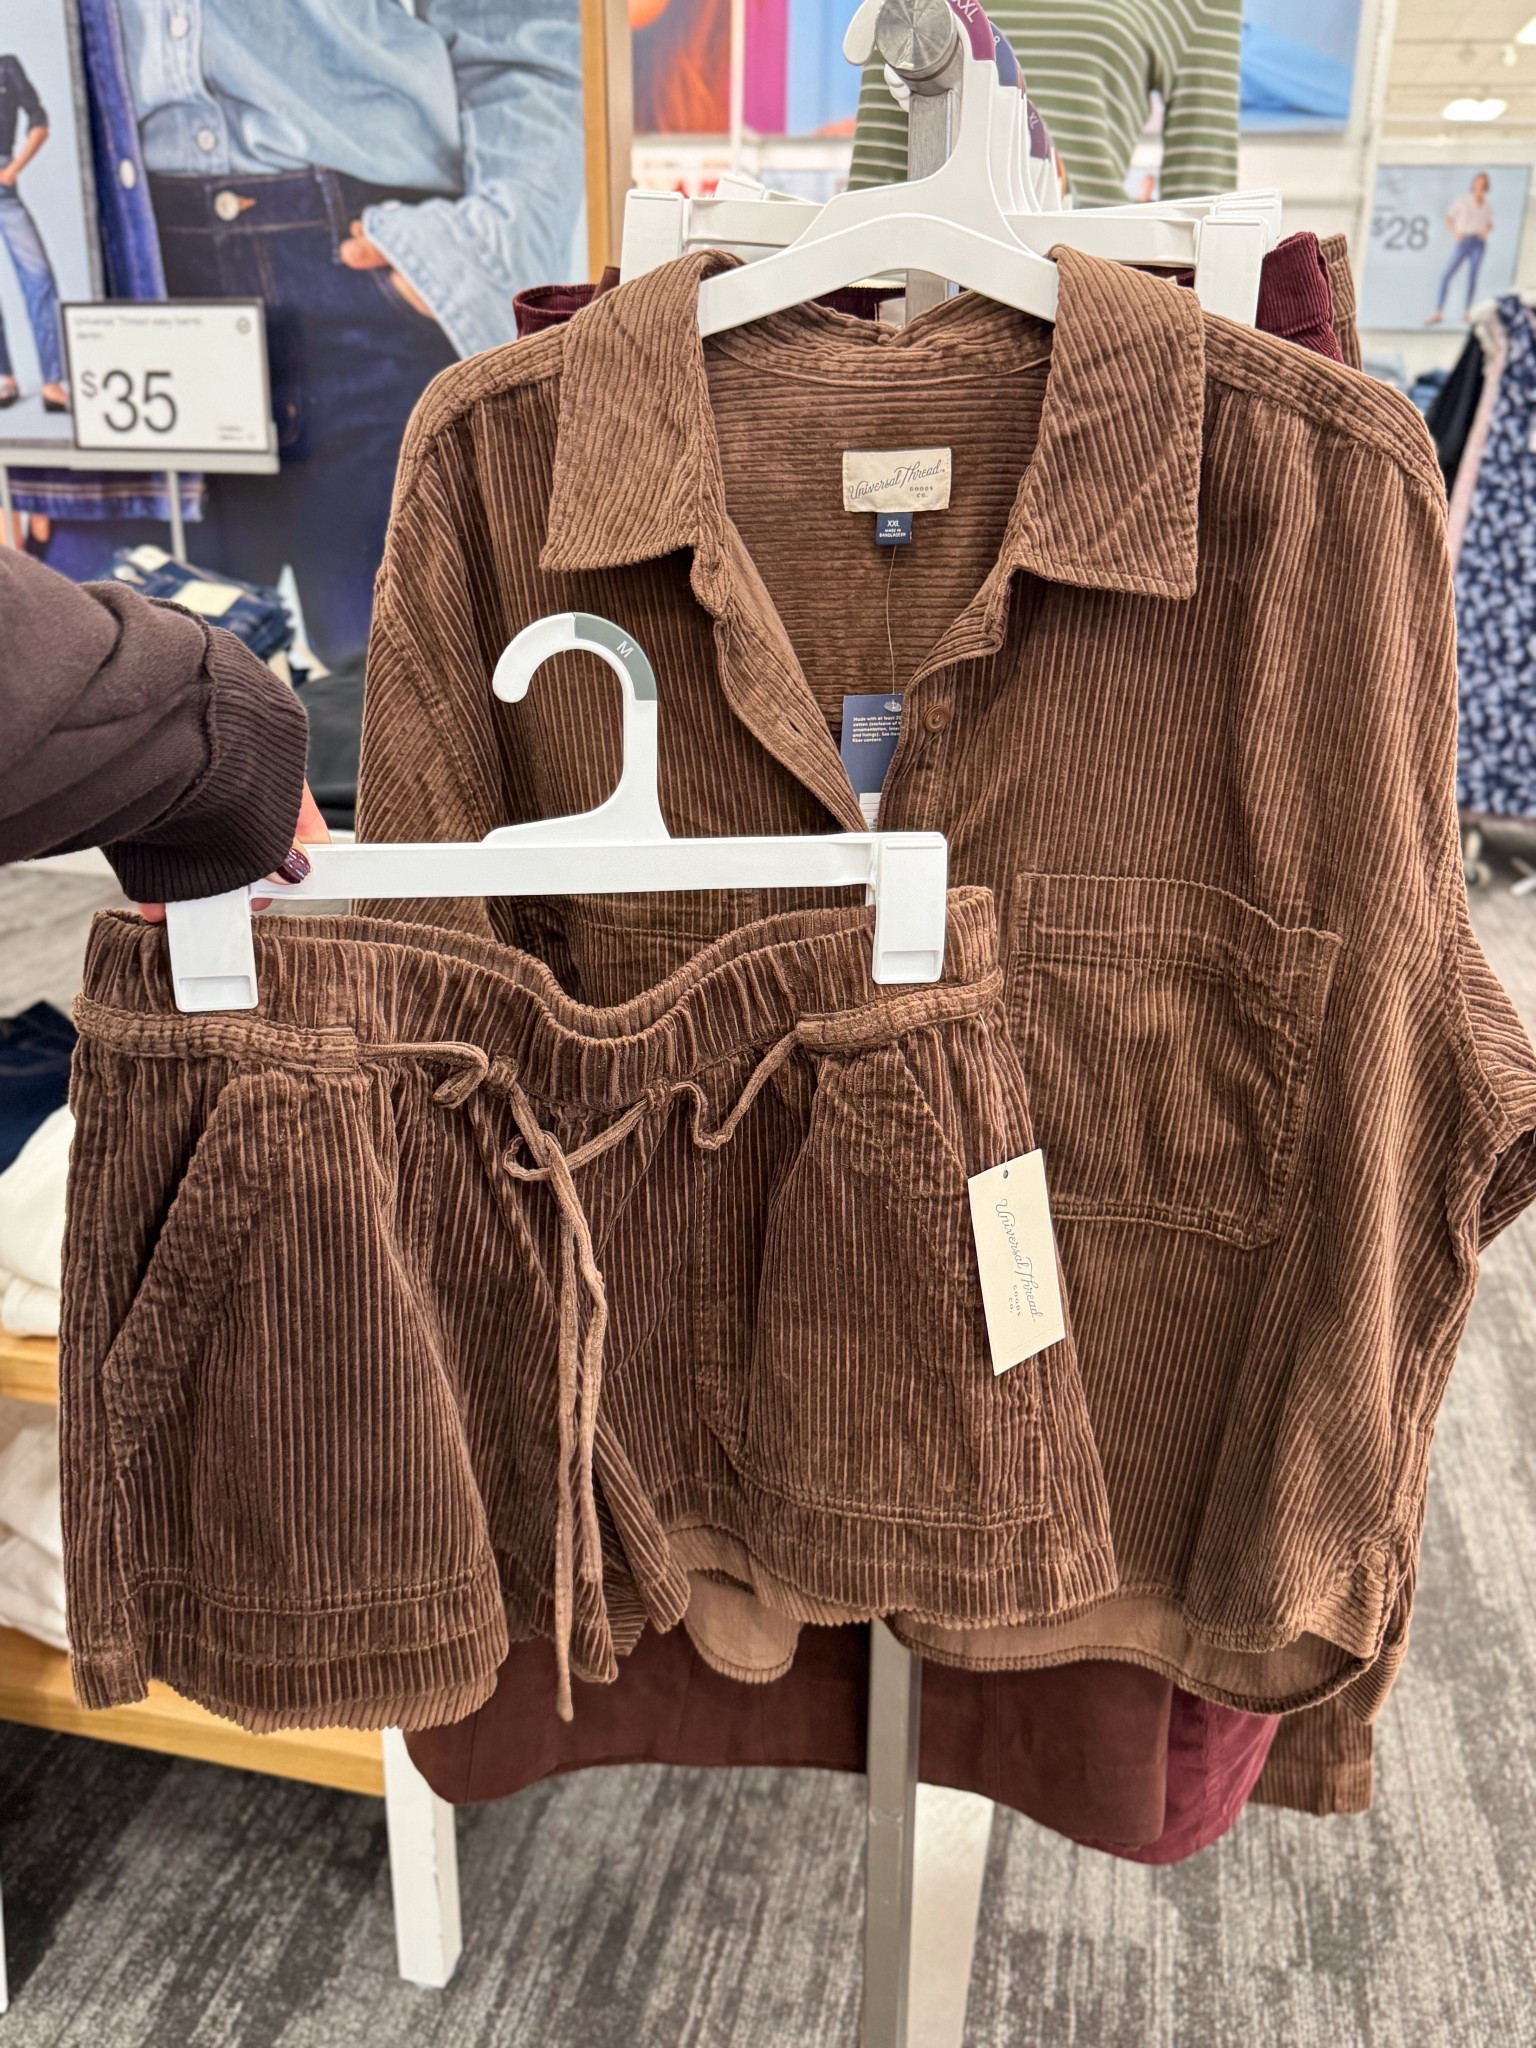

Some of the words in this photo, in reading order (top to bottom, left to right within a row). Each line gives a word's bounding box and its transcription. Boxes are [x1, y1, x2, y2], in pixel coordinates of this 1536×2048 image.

[1029, 112, 1039, 130] XL
[1371, 216, 1429, 251] $28
[80, 370, 178, 433] $35
[848, 469, 901, 500] Universal
[894, 459, 942, 489] Thread
[886, 519, 900, 528] XXL
[616, 640, 634, 658] M
[995, 1198, 1028, 1275] Universal
[1014, 1256, 1044, 1319] Thread
[1012, 1284, 1021, 1317] GOODS
